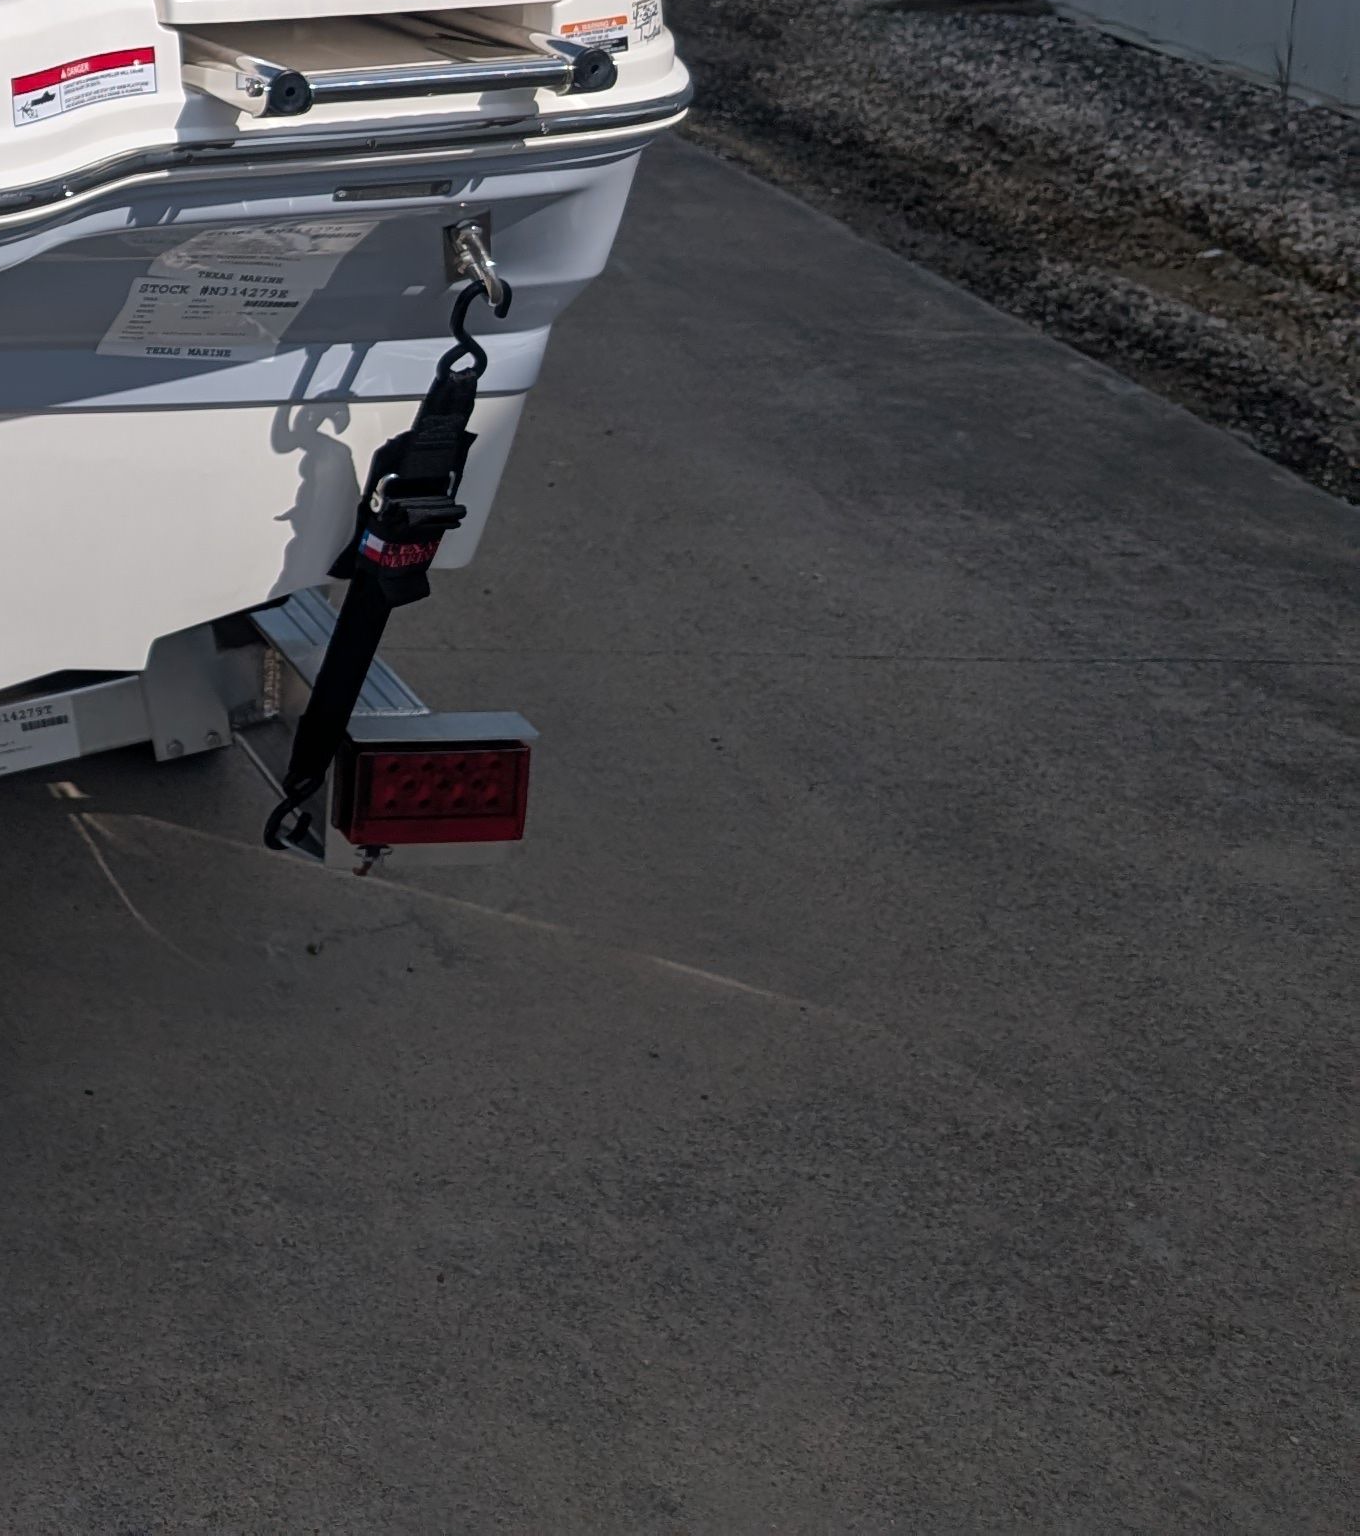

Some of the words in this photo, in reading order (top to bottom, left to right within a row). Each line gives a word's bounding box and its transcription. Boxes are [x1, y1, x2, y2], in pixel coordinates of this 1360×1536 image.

[138, 284, 190, 295] STOCK
[145, 347, 180, 356] TEXAS
[187, 348, 231, 358] MARINE
